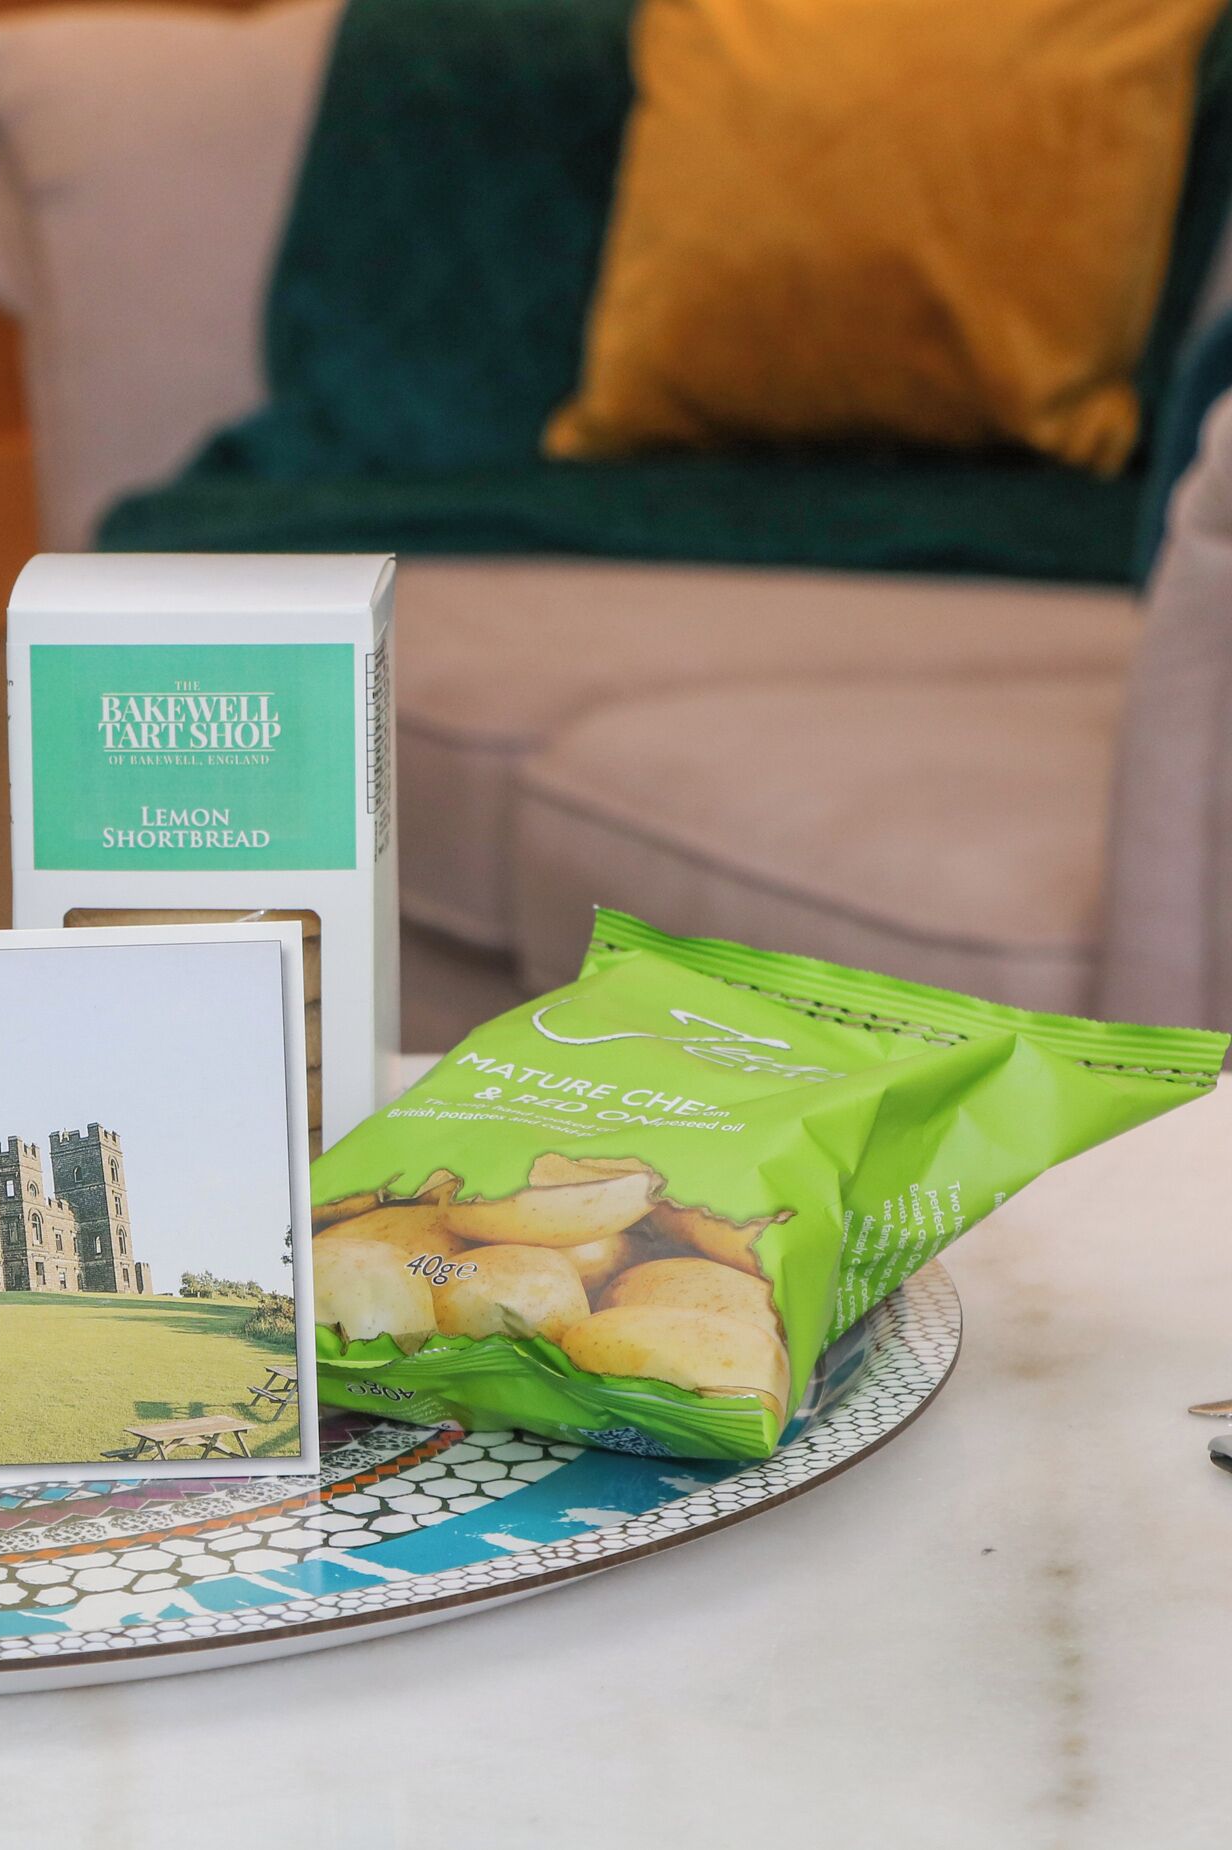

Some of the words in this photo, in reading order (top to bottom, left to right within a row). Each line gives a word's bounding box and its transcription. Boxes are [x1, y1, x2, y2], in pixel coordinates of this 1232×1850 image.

[175, 680, 200, 691] THE
[101, 696, 279, 722] BAKEWELL
[98, 722, 184, 749] TART
[189, 722, 282, 749] SHOP
[108, 755, 125, 765] OF
[208, 755, 270, 765] ENGLAND
[141, 805, 230, 827] LEMON
[103, 827, 270, 849] SHORTBREAD
[456, 1052, 617, 1100] MATURE
[621, 1089, 717, 1116] CHE
[387, 1107, 435, 1119] British
[436, 1109, 505, 1120] potatoes
[721, 1123, 745, 1132] oil
[474, 1087, 502, 1100] &
[509, 1094, 588, 1113] RED
[596, 1110, 664, 1126] ON
[897, 1195, 908, 1224] with
[909, 1184, 926, 1225] British
[947, 1181, 961, 1213] Two
[925, 1190, 945, 1236] perfect
[852, 1215, 876, 1255] delicately
[873, 1224, 894, 1251] family
